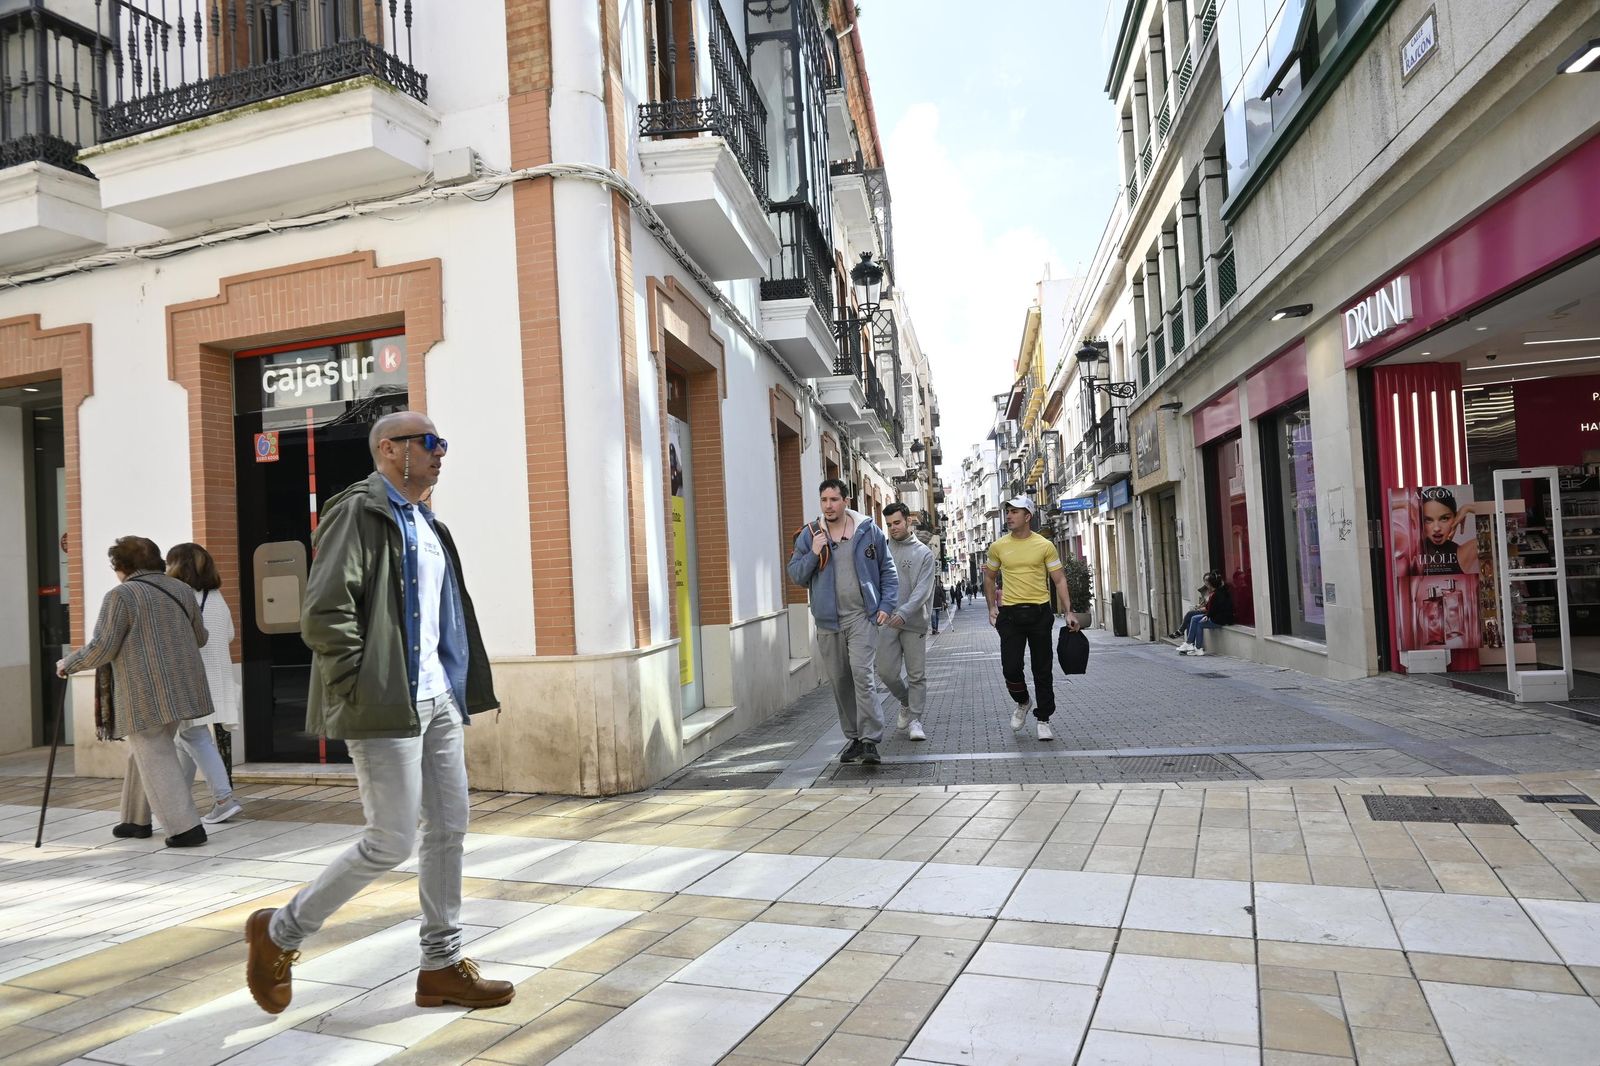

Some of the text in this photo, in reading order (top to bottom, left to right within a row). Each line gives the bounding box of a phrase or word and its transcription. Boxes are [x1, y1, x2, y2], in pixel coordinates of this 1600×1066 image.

[1410, 28, 1424, 47] CALLE
[1345, 276, 1408, 349] DRUNI
[262, 348, 397, 397] cajasur k
[1592, 392, 1600, 401] P
